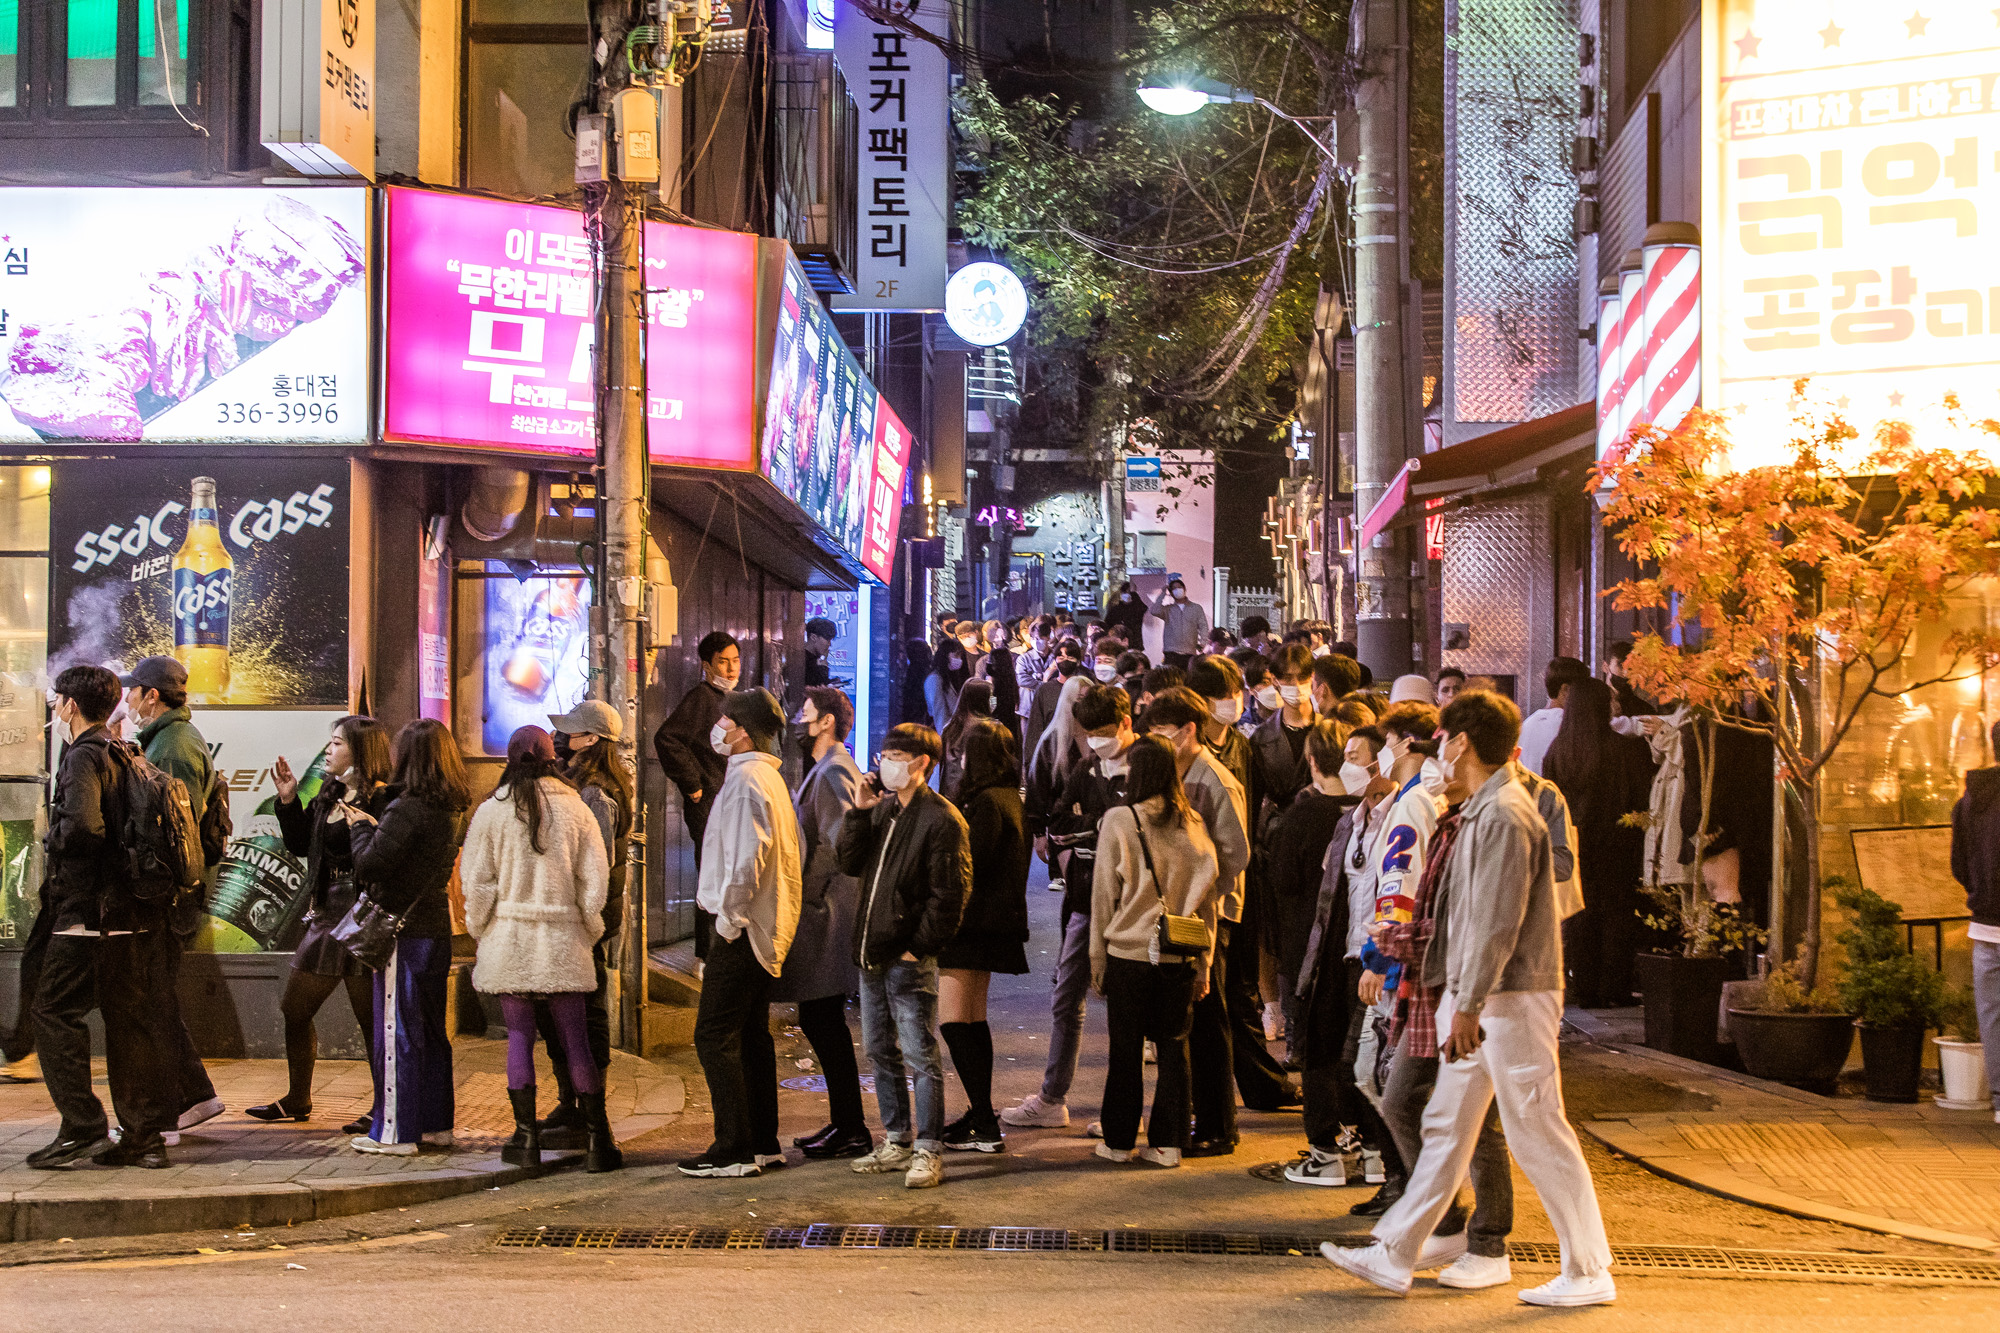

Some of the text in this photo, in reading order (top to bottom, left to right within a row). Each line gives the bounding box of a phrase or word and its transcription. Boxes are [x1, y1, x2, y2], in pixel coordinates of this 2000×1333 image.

[868, 32, 911, 267] 포커팩토리
[505, 228, 534, 265] 이
[875, 279, 900, 299] 2F
[271, 373, 338, 398] 홍대점
[216, 402, 340, 424] 336-3996
[1383, 824, 1418, 873] 2
